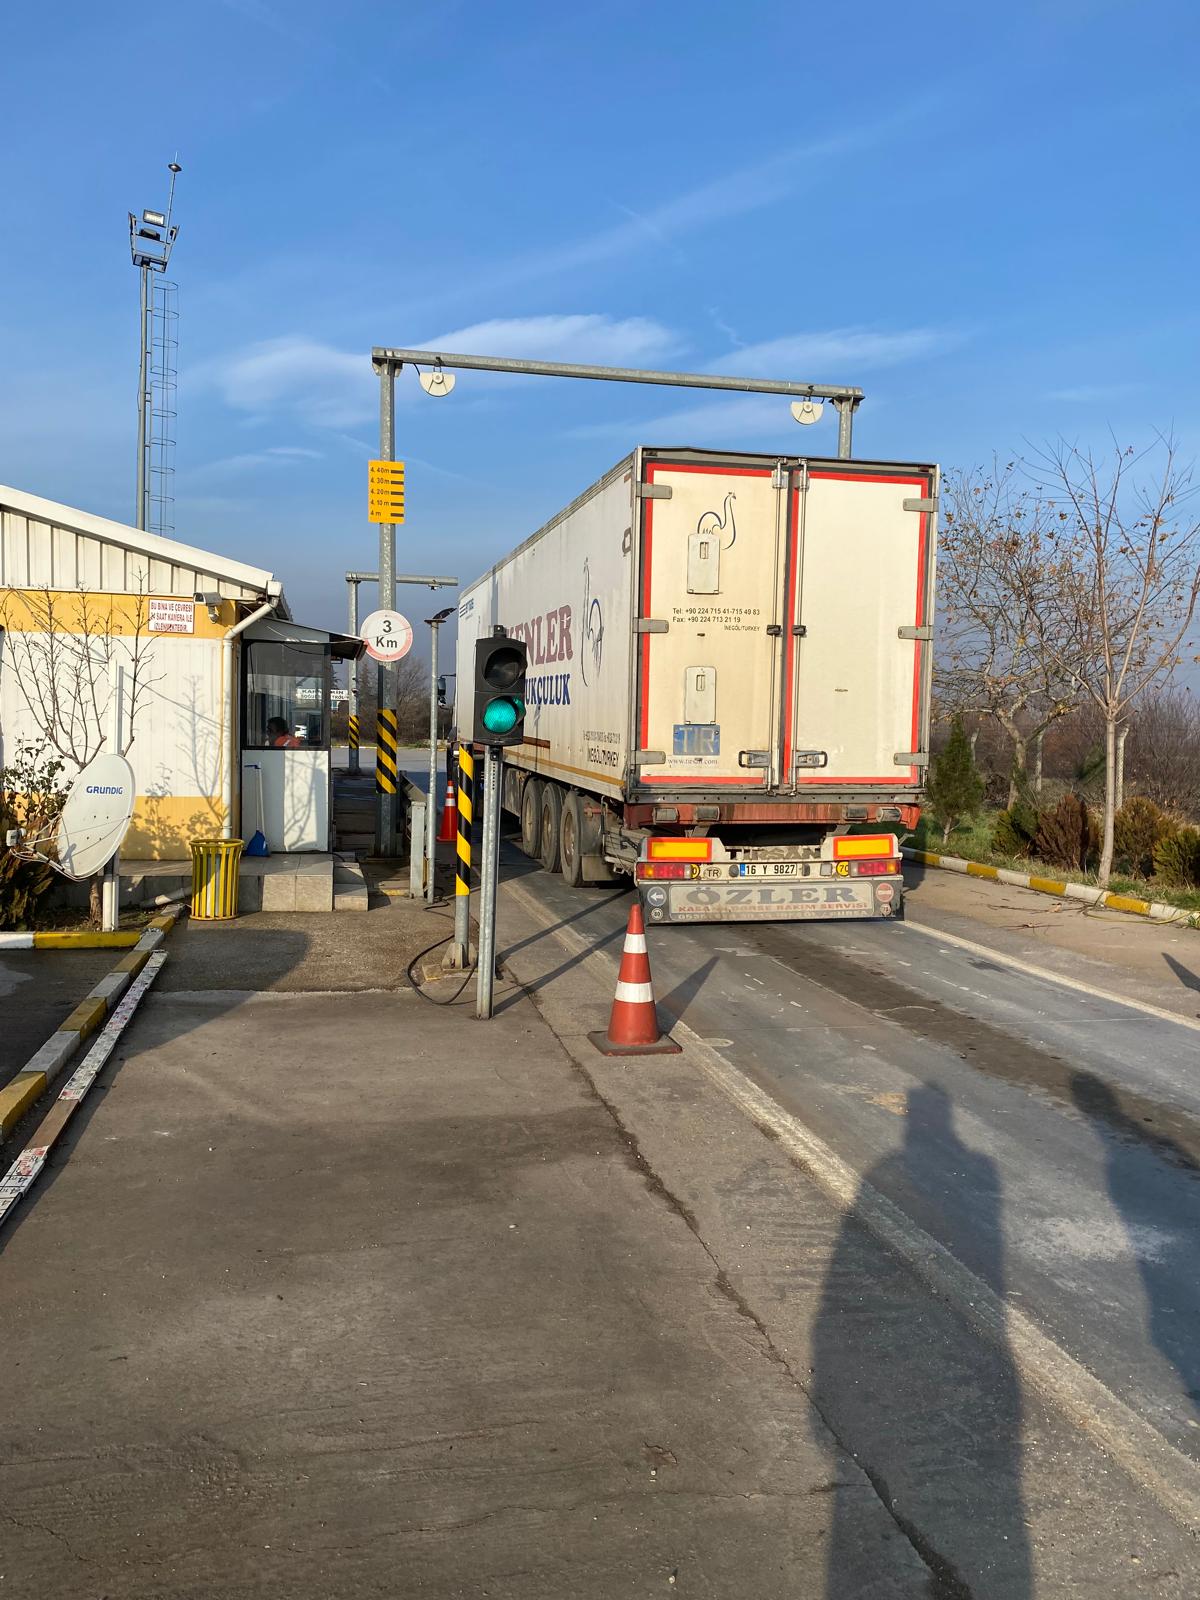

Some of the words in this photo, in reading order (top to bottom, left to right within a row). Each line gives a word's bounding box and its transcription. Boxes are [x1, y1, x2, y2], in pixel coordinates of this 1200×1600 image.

[157, 613, 167, 621] SAAT
[382, 619, 392, 633] 3
[376, 636, 398, 648] Km
[86, 785, 124, 795] GRUNDIG
[707, 868, 720, 877] TR
[746, 864, 757, 875] 16
[763, 864, 768, 874] Y
[774, 863, 796, 874] 9827
[686, 886, 858, 904] ÖZLER
